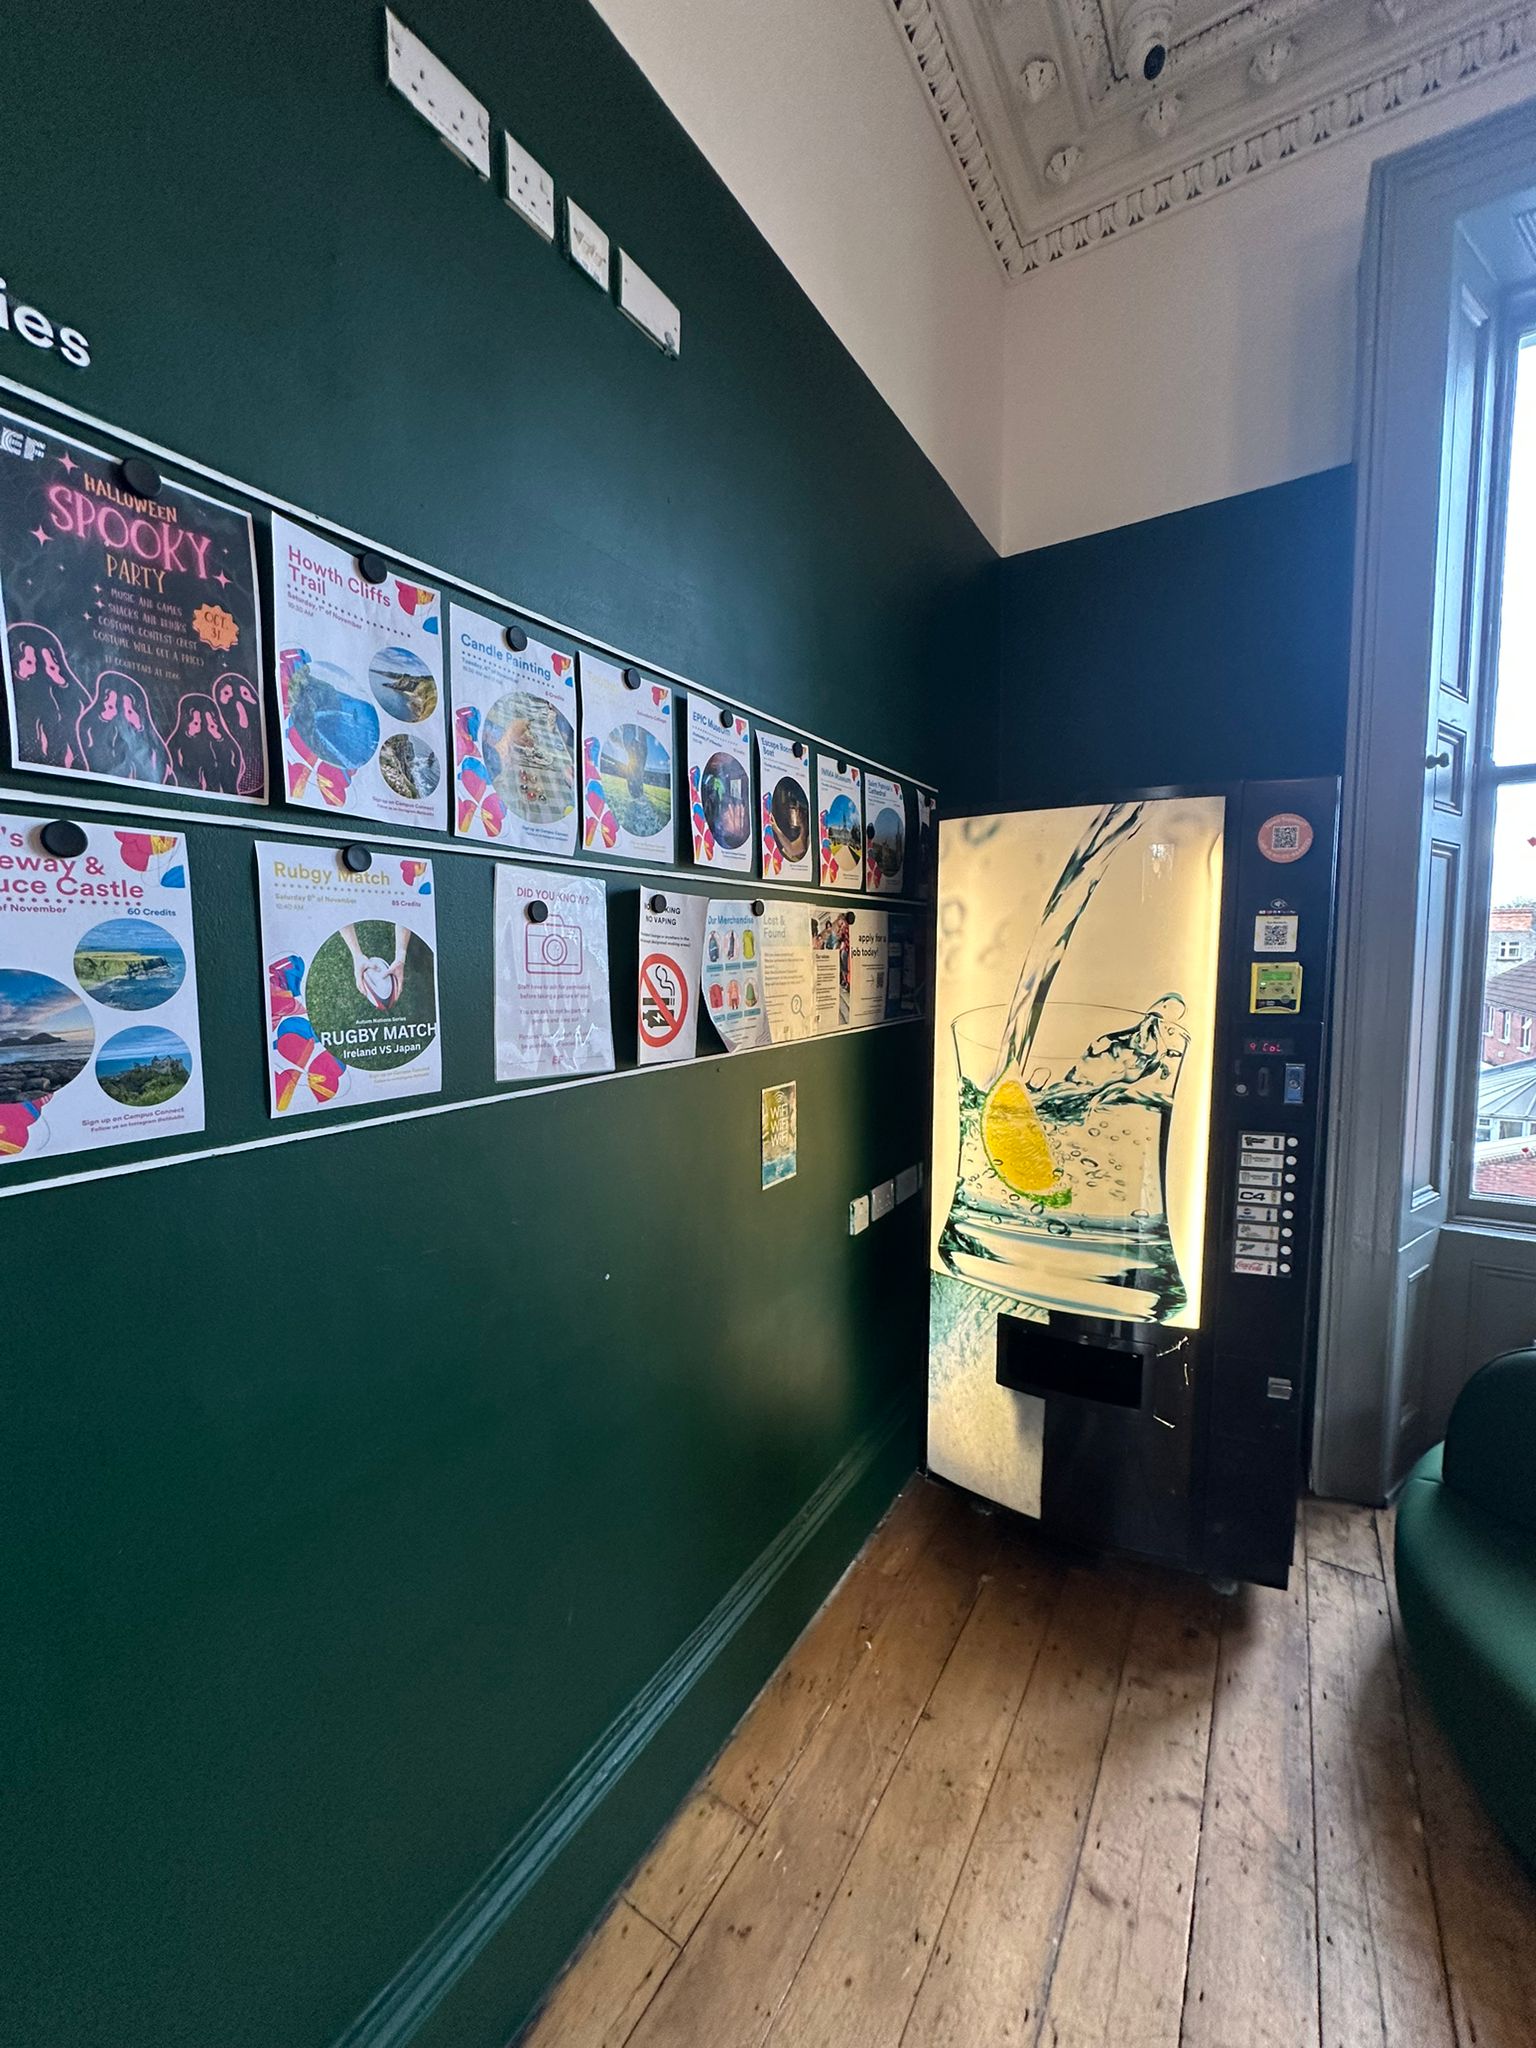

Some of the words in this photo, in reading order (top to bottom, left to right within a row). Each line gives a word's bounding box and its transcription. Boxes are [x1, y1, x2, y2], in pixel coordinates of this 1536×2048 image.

[84, 473, 177, 523] HALLOWEEN
[49, 485, 211, 580] SPOOKY
[106, 554, 166, 594] PARTY
[288, 544, 343, 587] Howth
[347, 577, 391, 607] Cliffs
[288, 563, 326, 596] Trail
[108, 603, 139, 620] SNACKS
[111, 588, 135, 604] MUSIC
[157, 602, 183, 617] GAMES
[98, 616, 135, 635] COSTUME
[138, 627, 173, 645] CONTEST
[93, 630, 130, 649] COSTUME
[133, 641, 153, 655] WILL
[461, 633, 503, 661] Candle
[506, 652, 551, 681] Painting
[85, 856, 105, 875] &
[273, 861, 333, 886] Rubgy
[338, 867, 390, 886] Match
[56, 876, 144, 898] Castle
[517, 886, 534, 898] DID
[535, 888, 555, 901] YOU
[10, 904, 67, 913] November
[127, 907, 140, 916] 60
[143, 908, 177, 917] Credits
[400, 900, 422, 908] Credits
[653, 917, 677, 926] VAPING
[858, 933, 875, 943] apply
[851, 947, 861, 959] job
[320, 1026, 379, 1047] RUGBY
[383, 1022, 438, 1041] MATCH
[343, 1046, 377, 1059] Ireland
[379, 1045, 392, 1054] VS
[393, 1043, 421, 1055] Japan
[123, 1111, 154, 1121] Campus
[154, 1106, 185, 1116] Connect
[1240, 1191, 1266, 1202] C4
